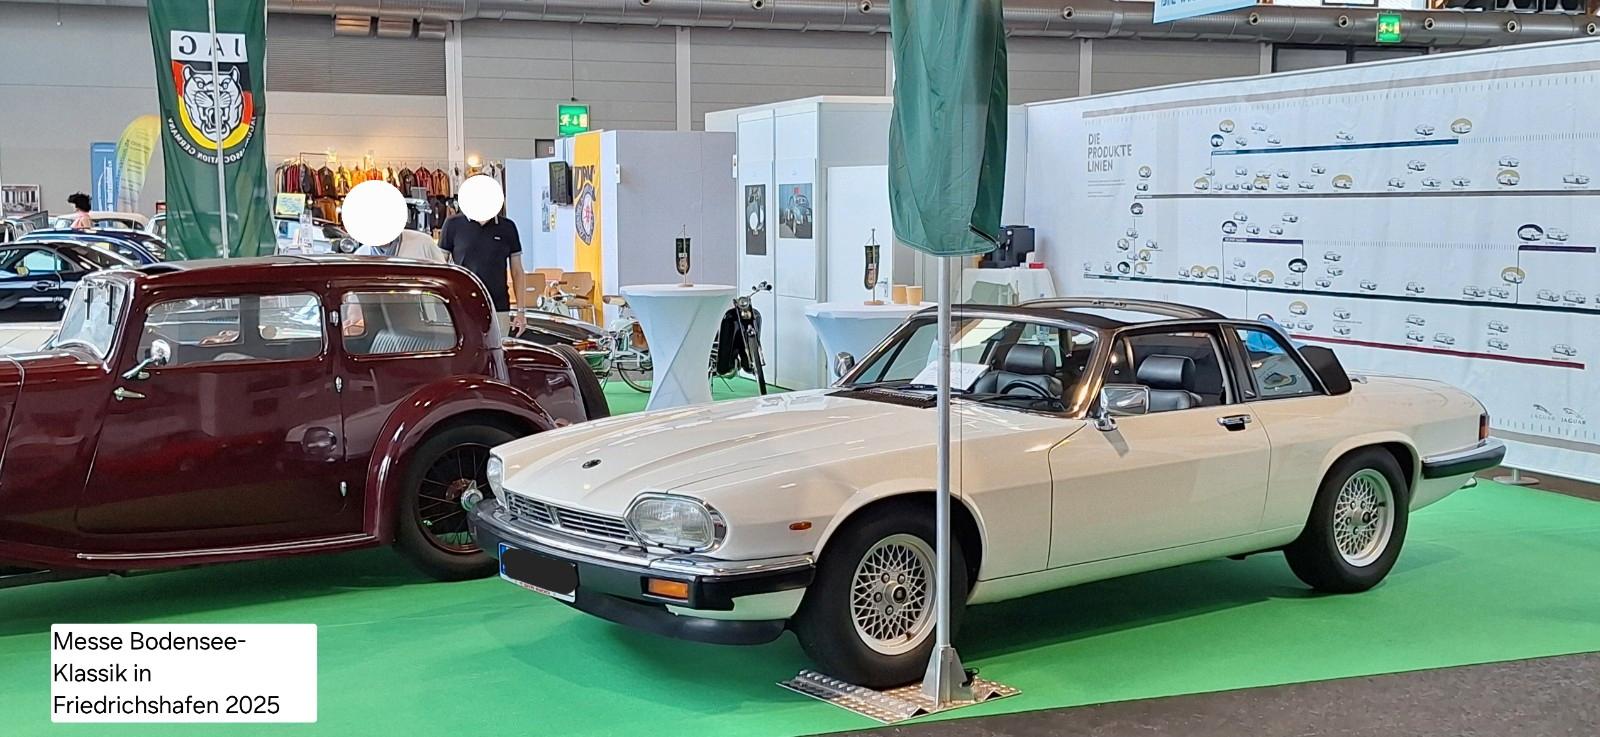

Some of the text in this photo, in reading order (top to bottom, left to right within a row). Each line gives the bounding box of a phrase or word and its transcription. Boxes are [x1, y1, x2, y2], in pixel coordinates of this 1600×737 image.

[1088, 132, 1101, 145] DIE
[1087, 144, 1132, 159] PRODUKTE
[1087, 160, 1113, 173] LINIEN
[1561, 417, 1586, 425] JAGUAR
